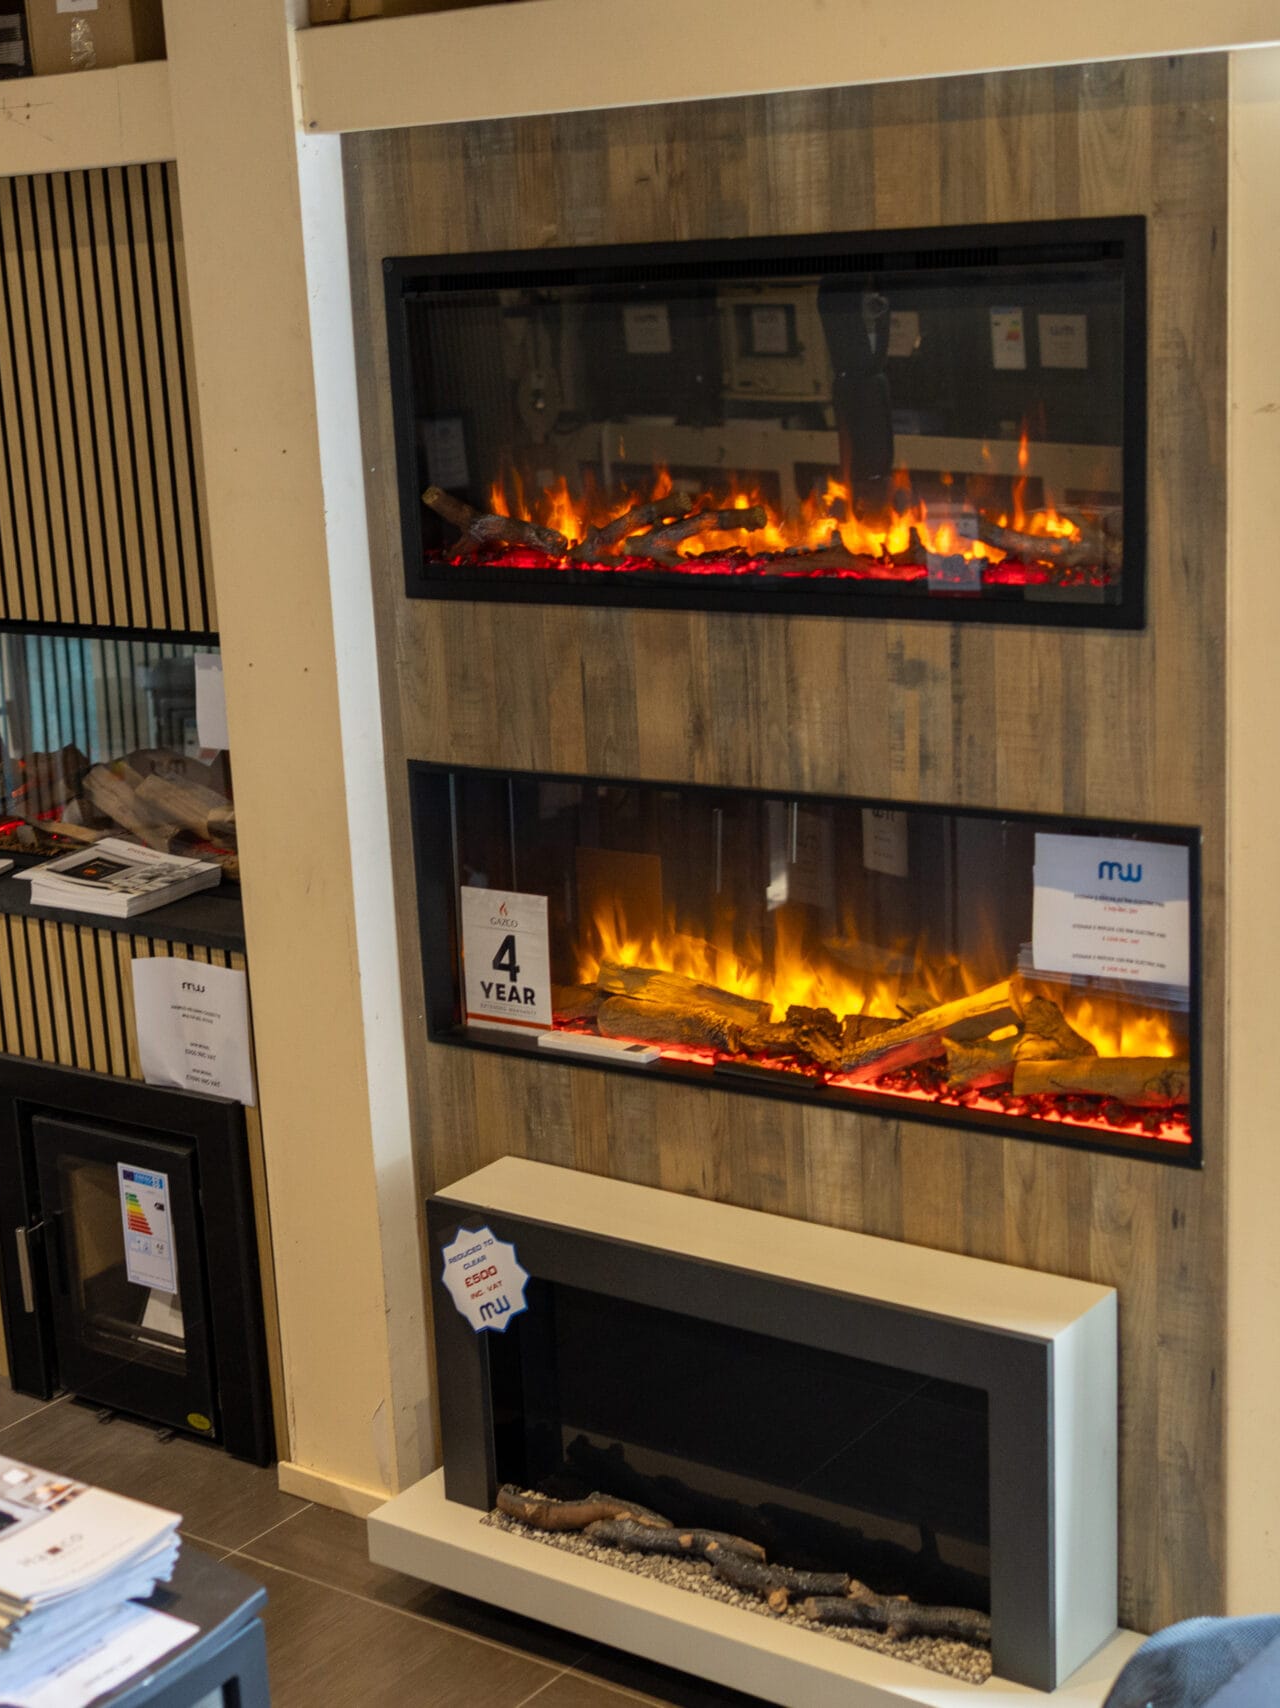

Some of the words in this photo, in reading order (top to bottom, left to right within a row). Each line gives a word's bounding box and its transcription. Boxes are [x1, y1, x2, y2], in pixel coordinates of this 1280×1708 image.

[489, 916, 519, 929] GAZCO
[492, 934, 520, 983] 4
[480, 981, 536, 1006] YEAR
[448, 1244, 482, 1264] REDUCED
[483, 1238, 495, 1248] TO
[463, 1254, 488, 1270] CLEAR
[464, 1265, 498, 1288] £500
[487, 1280, 503, 1291] VAT
